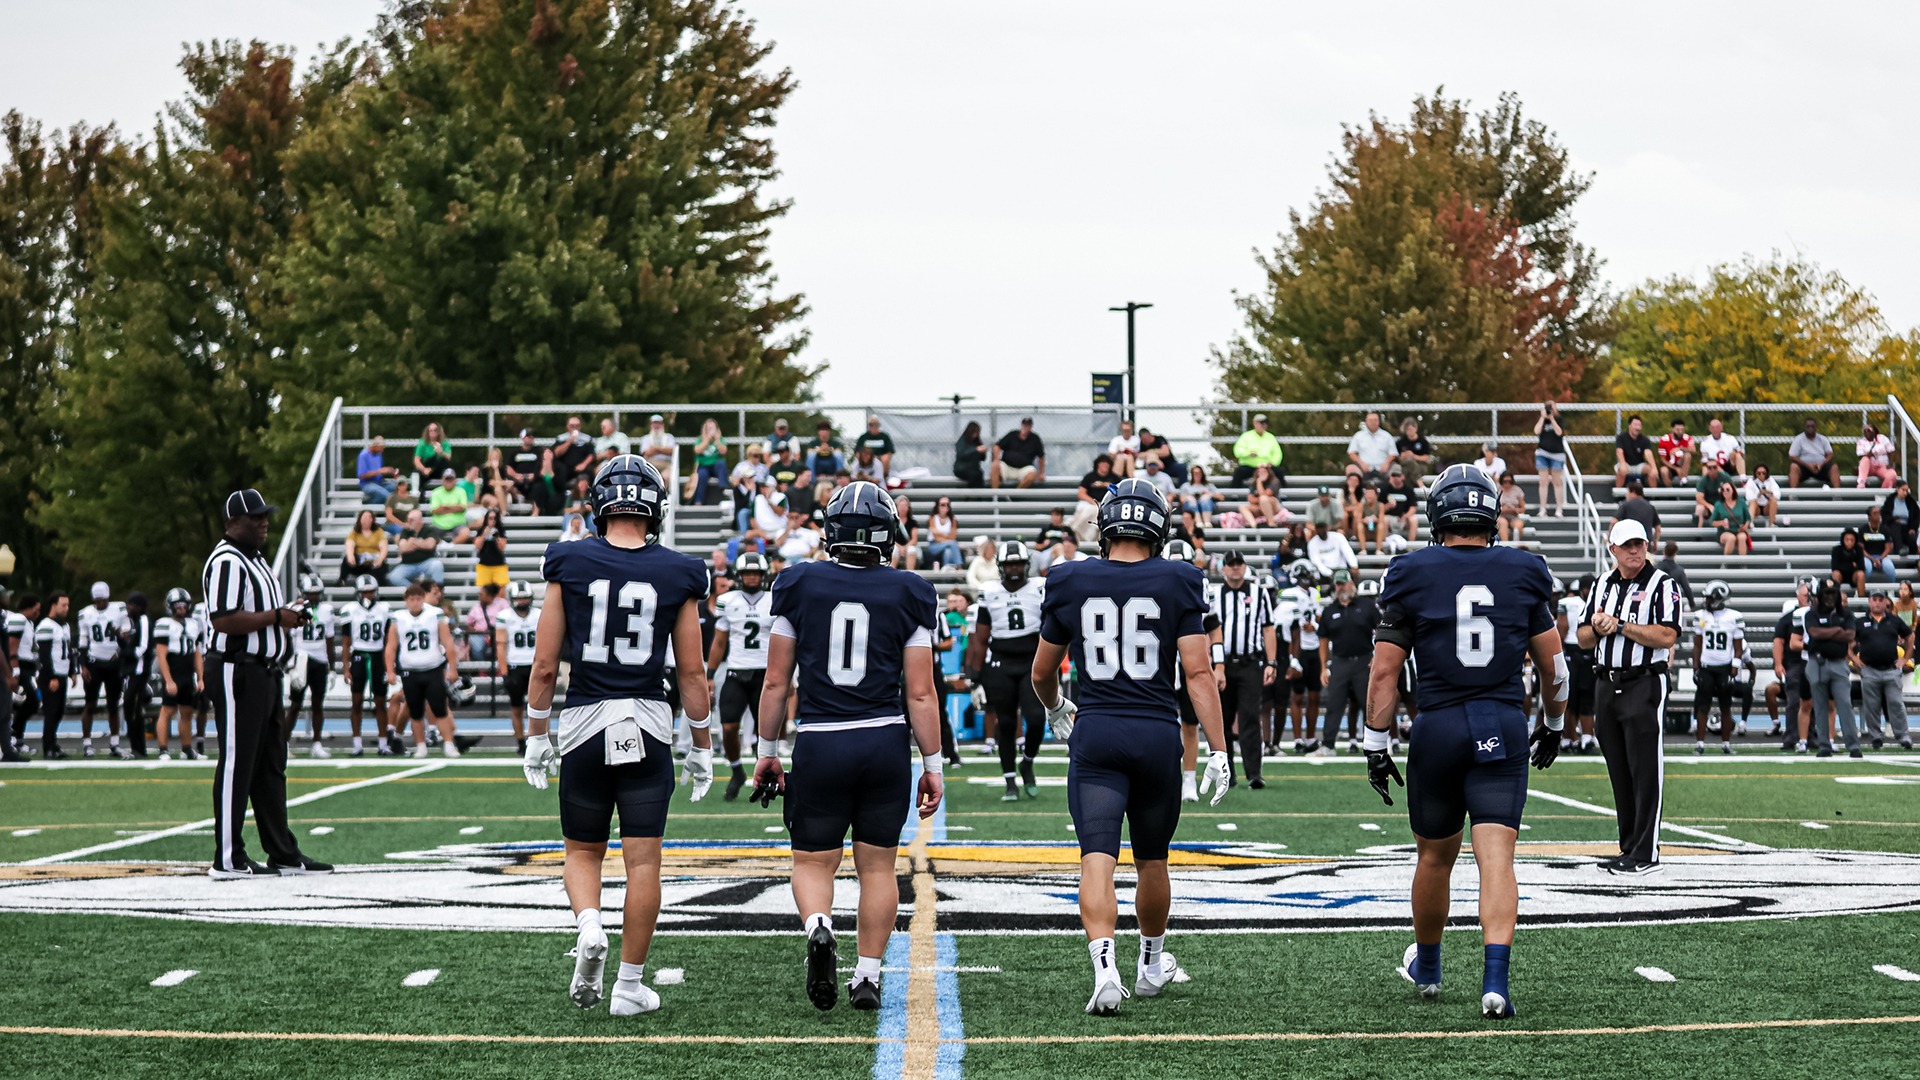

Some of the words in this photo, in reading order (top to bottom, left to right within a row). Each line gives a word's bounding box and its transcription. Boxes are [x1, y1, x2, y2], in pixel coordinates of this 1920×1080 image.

[616, 484, 638, 502] 13
[1468, 490, 1479, 508] 6
[1121, 503, 1145, 522] 86
[582, 579, 658, 666] 13
[1008, 608, 1025, 631] 8
[1456, 584, 1495, 668] 6
[1629, 612, 1638, 624] R
[405, 630, 430, 652] 26
[743, 620, 760, 650] 2
[827, 601, 870, 687] 0
[1080, 596, 1161, 681] 86
[1705, 630, 1728, 651] 39
[614, 738, 637, 753] LVC
[1476, 736, 1500, 753] LVC
